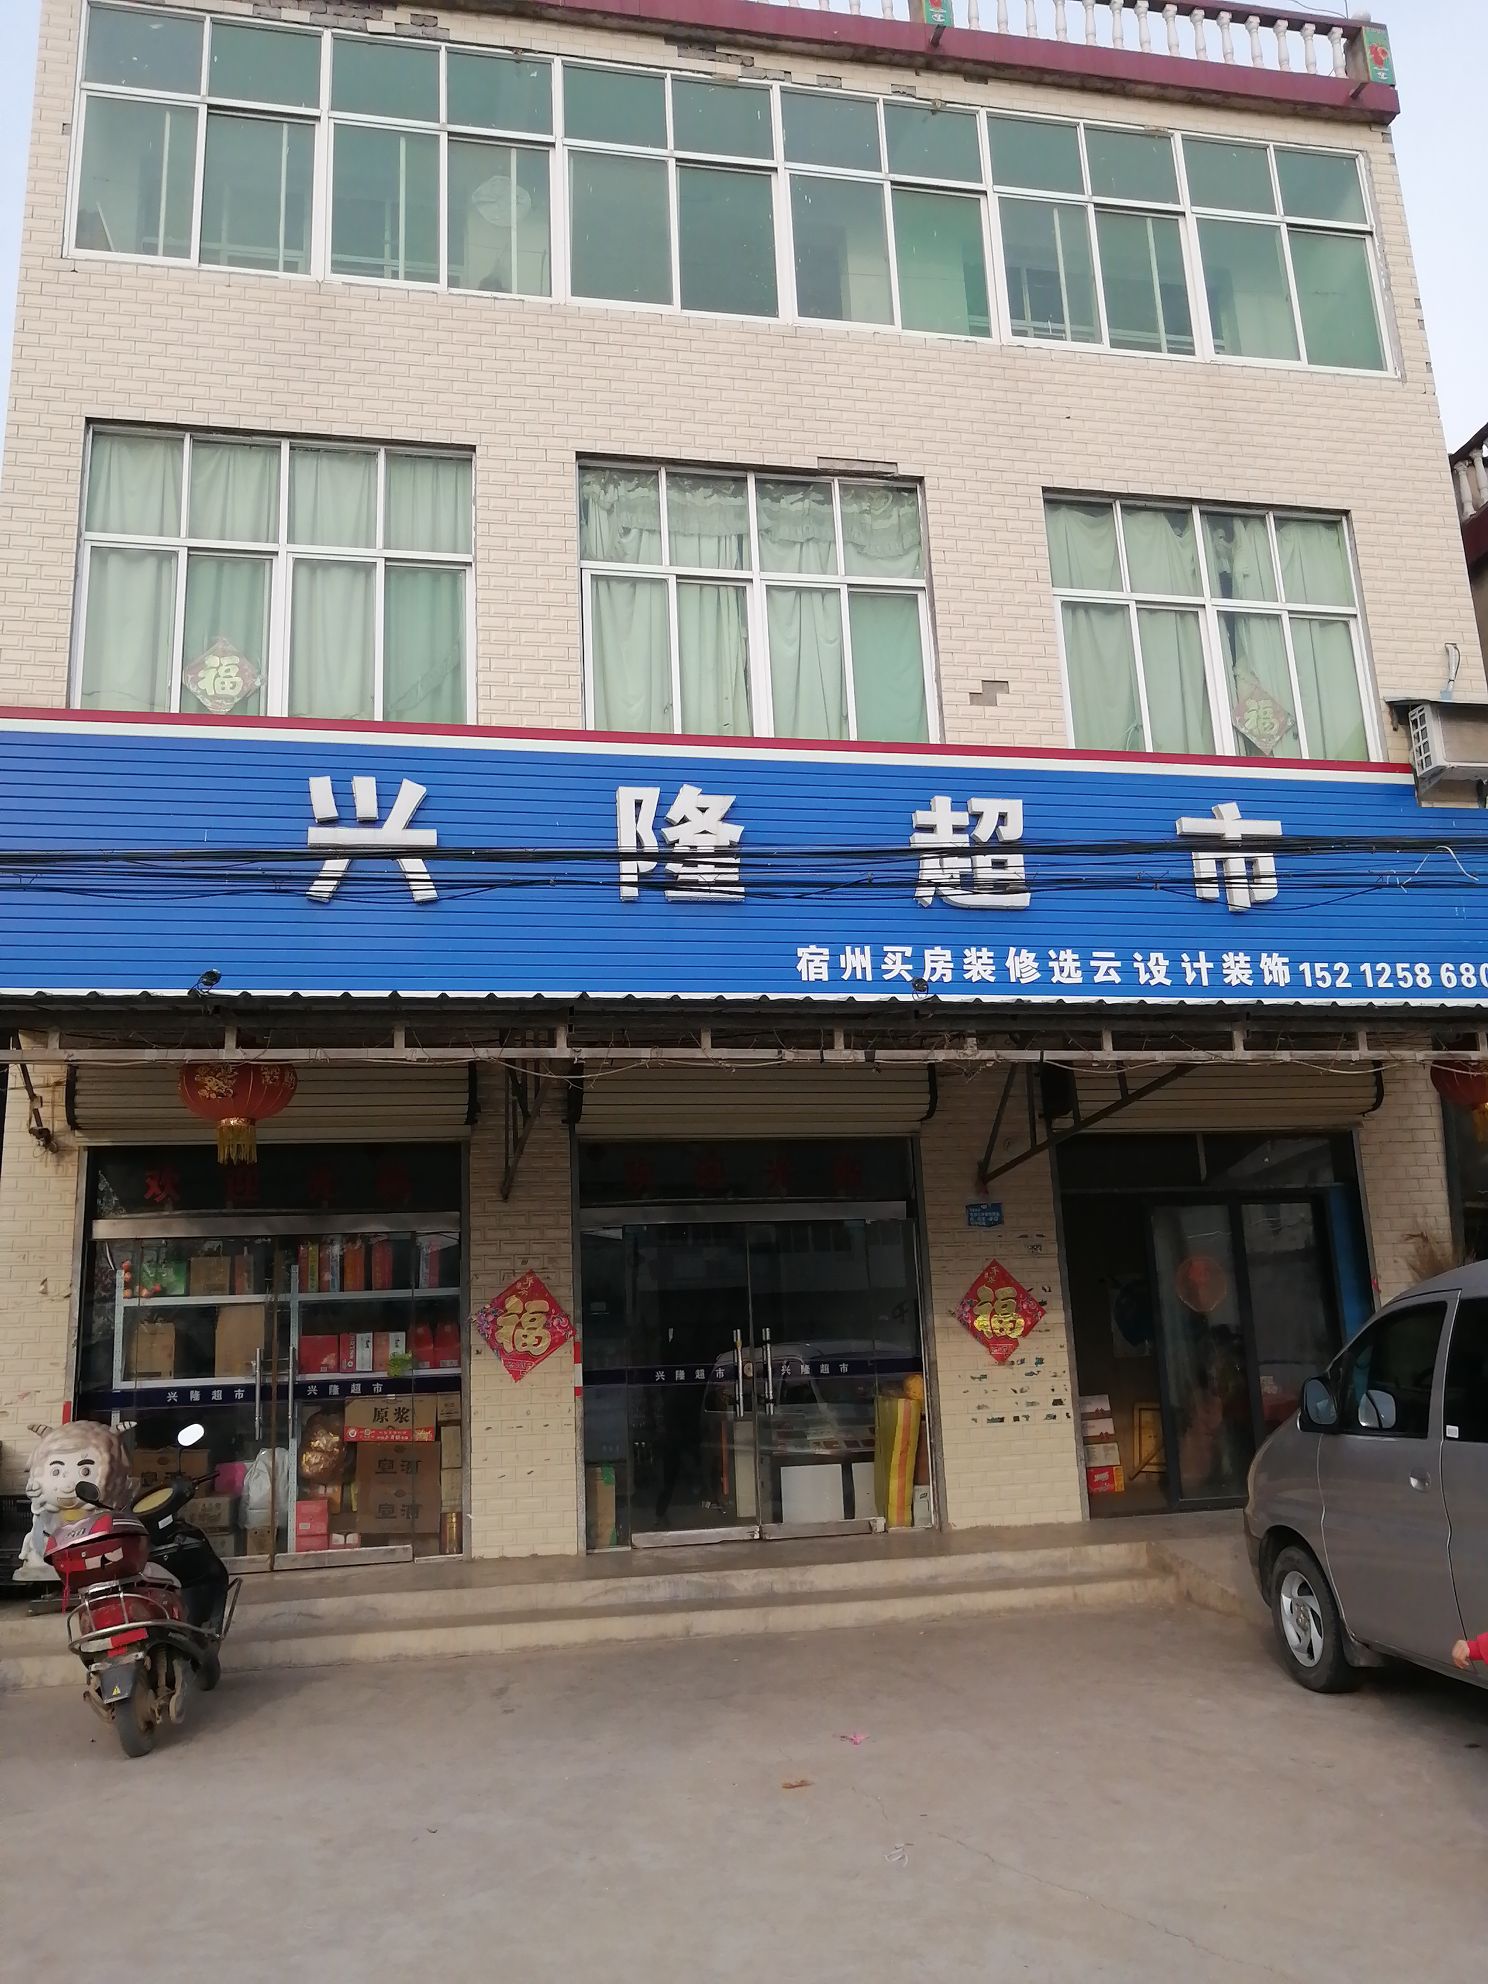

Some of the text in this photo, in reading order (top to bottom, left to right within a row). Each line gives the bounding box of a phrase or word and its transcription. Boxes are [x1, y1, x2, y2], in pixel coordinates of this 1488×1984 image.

[198, 654, 242, 698] 福
[1242, 697, 1277, 738] 福
[306, 774, 1283, 914] 兴隆超市
[796, 945, 1291, 988] 宿州买房装修选云设计装饰
[1298, 961, 1352, 990] 152
[1360, 962, 1433, 990] 1258
[494, 1294, 552, 1356] 福
[973, 1284, 1026, 1340] 福
[306, 1382, 384, 1397] 兴隆超市
[656, 1368, 725, 1382] 兴隆超市
[780, 1362, 849, 1377] 兴隆超市
[166, 1387, 246, 1403] 兴隆超市
[372, 1405, 412, 1424] 原浆
